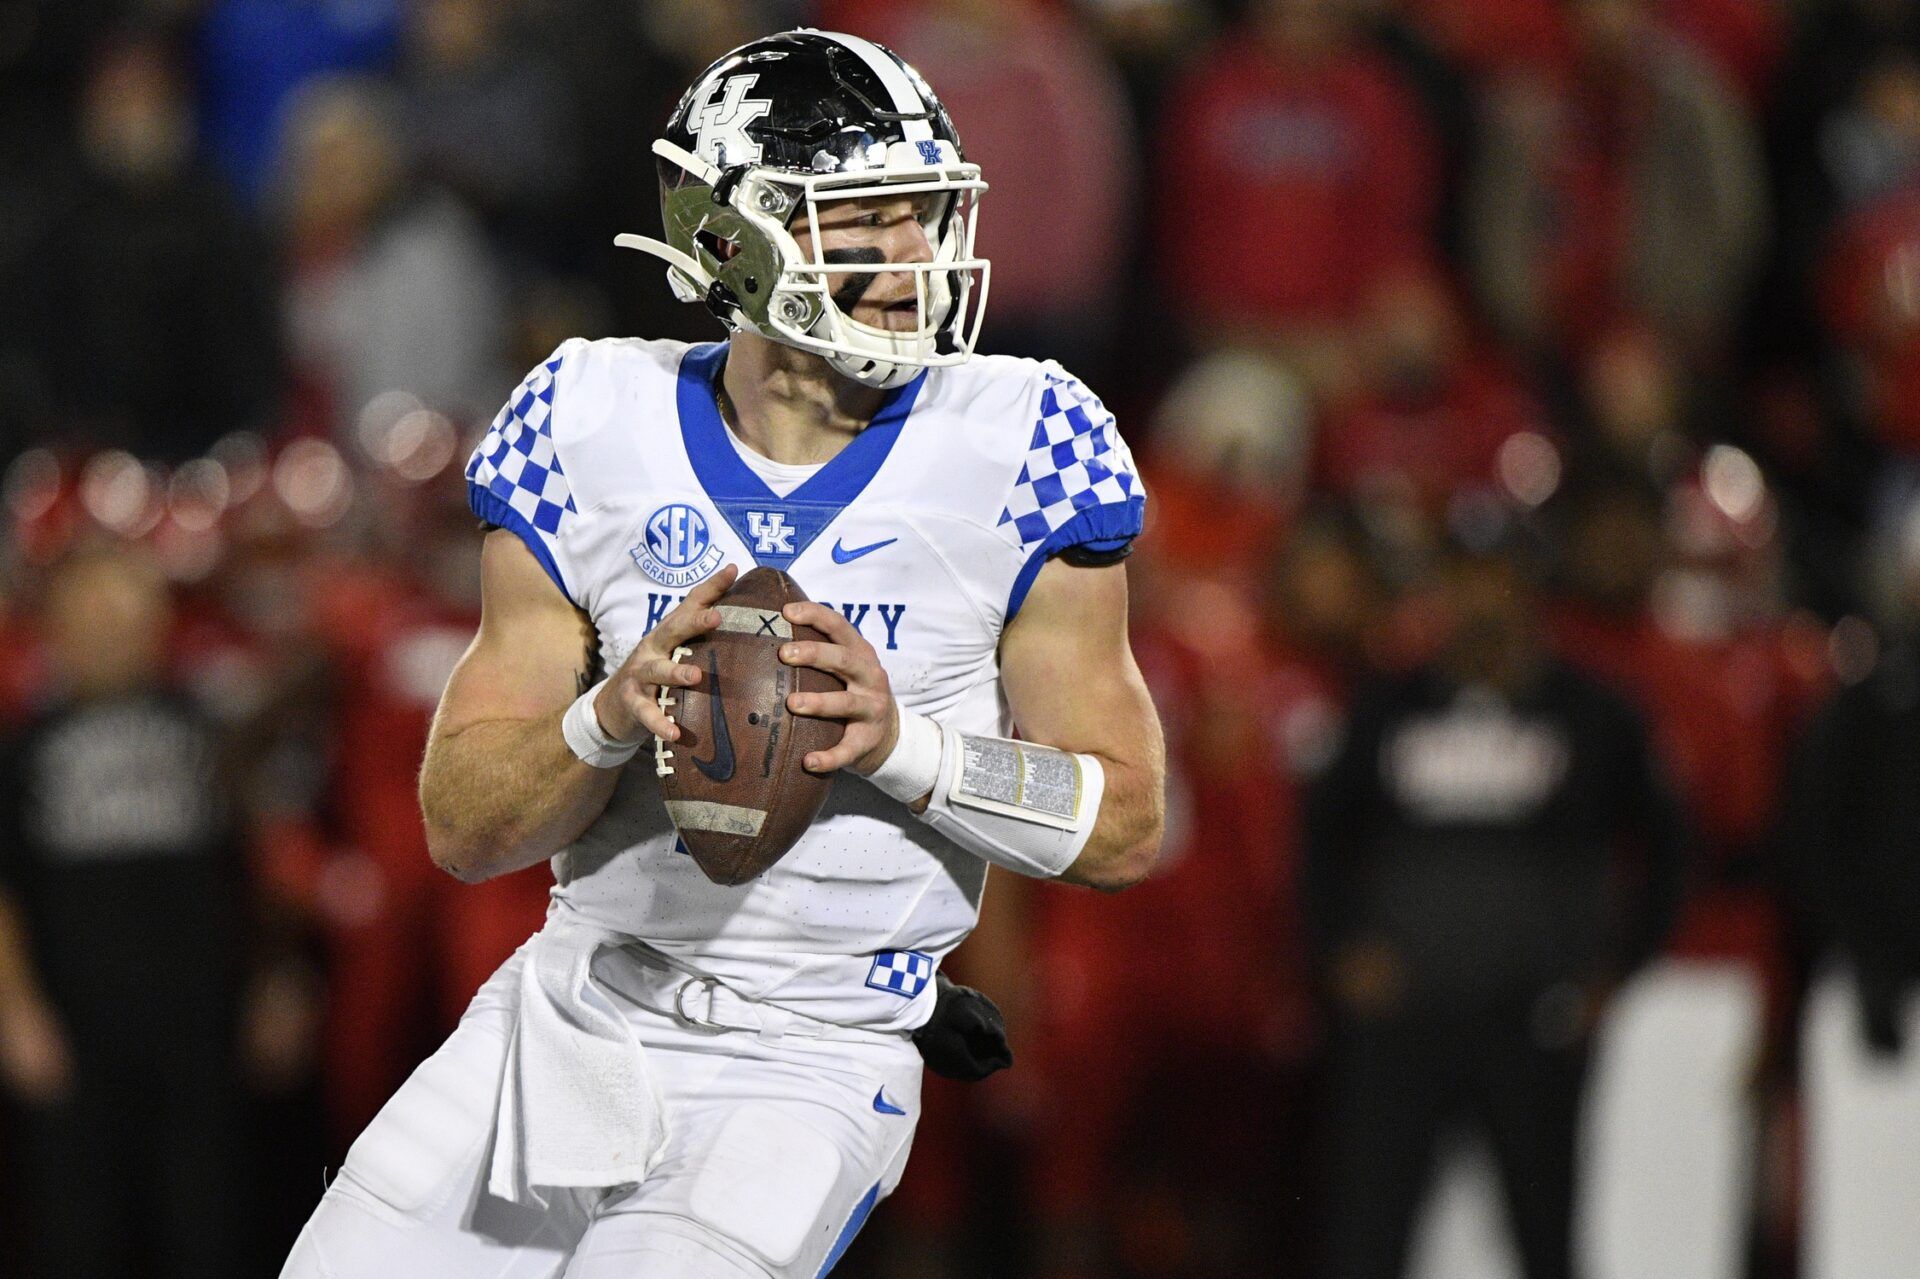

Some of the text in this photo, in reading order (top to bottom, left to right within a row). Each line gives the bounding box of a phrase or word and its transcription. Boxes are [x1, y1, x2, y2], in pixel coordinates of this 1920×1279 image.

[649, 507, 705, 566] SEC
[747, 512, 795, 554] UK
[642, 559, 711, 585] GRADUATE
